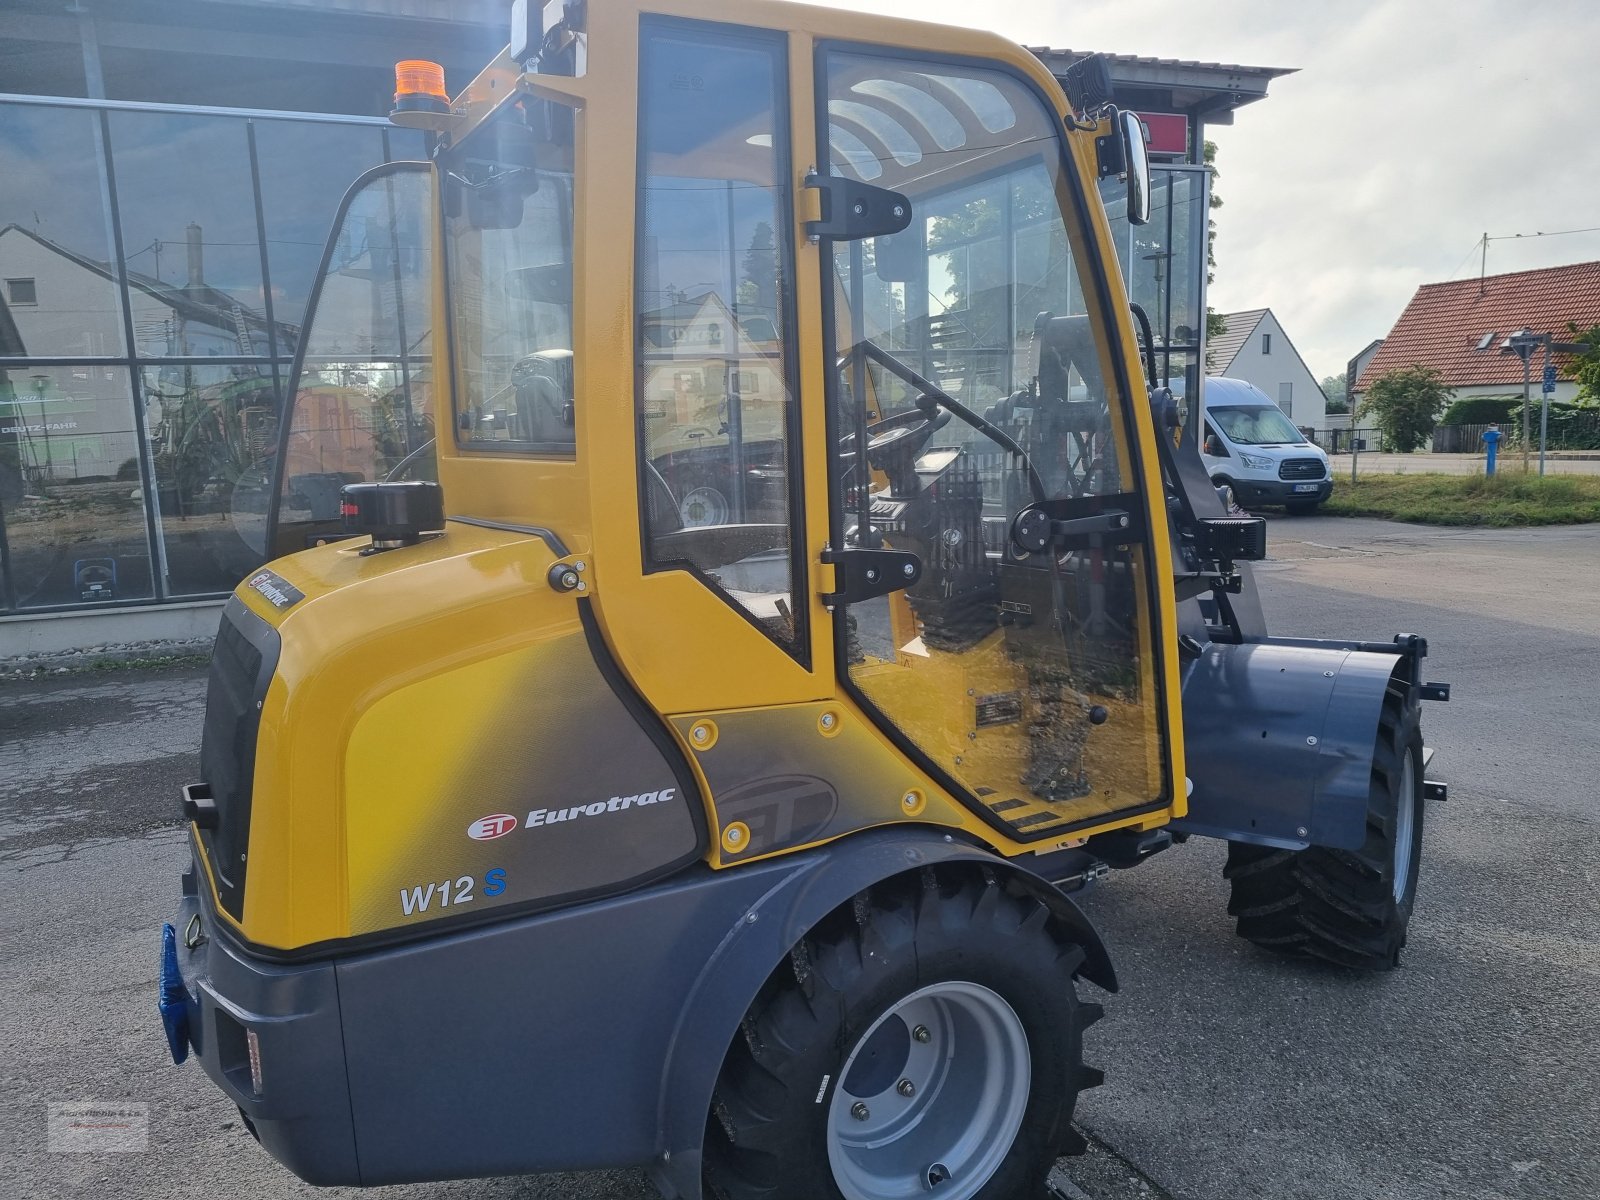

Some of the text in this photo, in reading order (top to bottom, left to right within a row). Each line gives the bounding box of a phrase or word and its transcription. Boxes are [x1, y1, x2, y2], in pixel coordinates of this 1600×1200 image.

[1, 422, 78, 434] DEUTZ-FAHR
[467, 787, 676, 841] ET Eurotrac
[400, 868, 507, 916] W12 S
